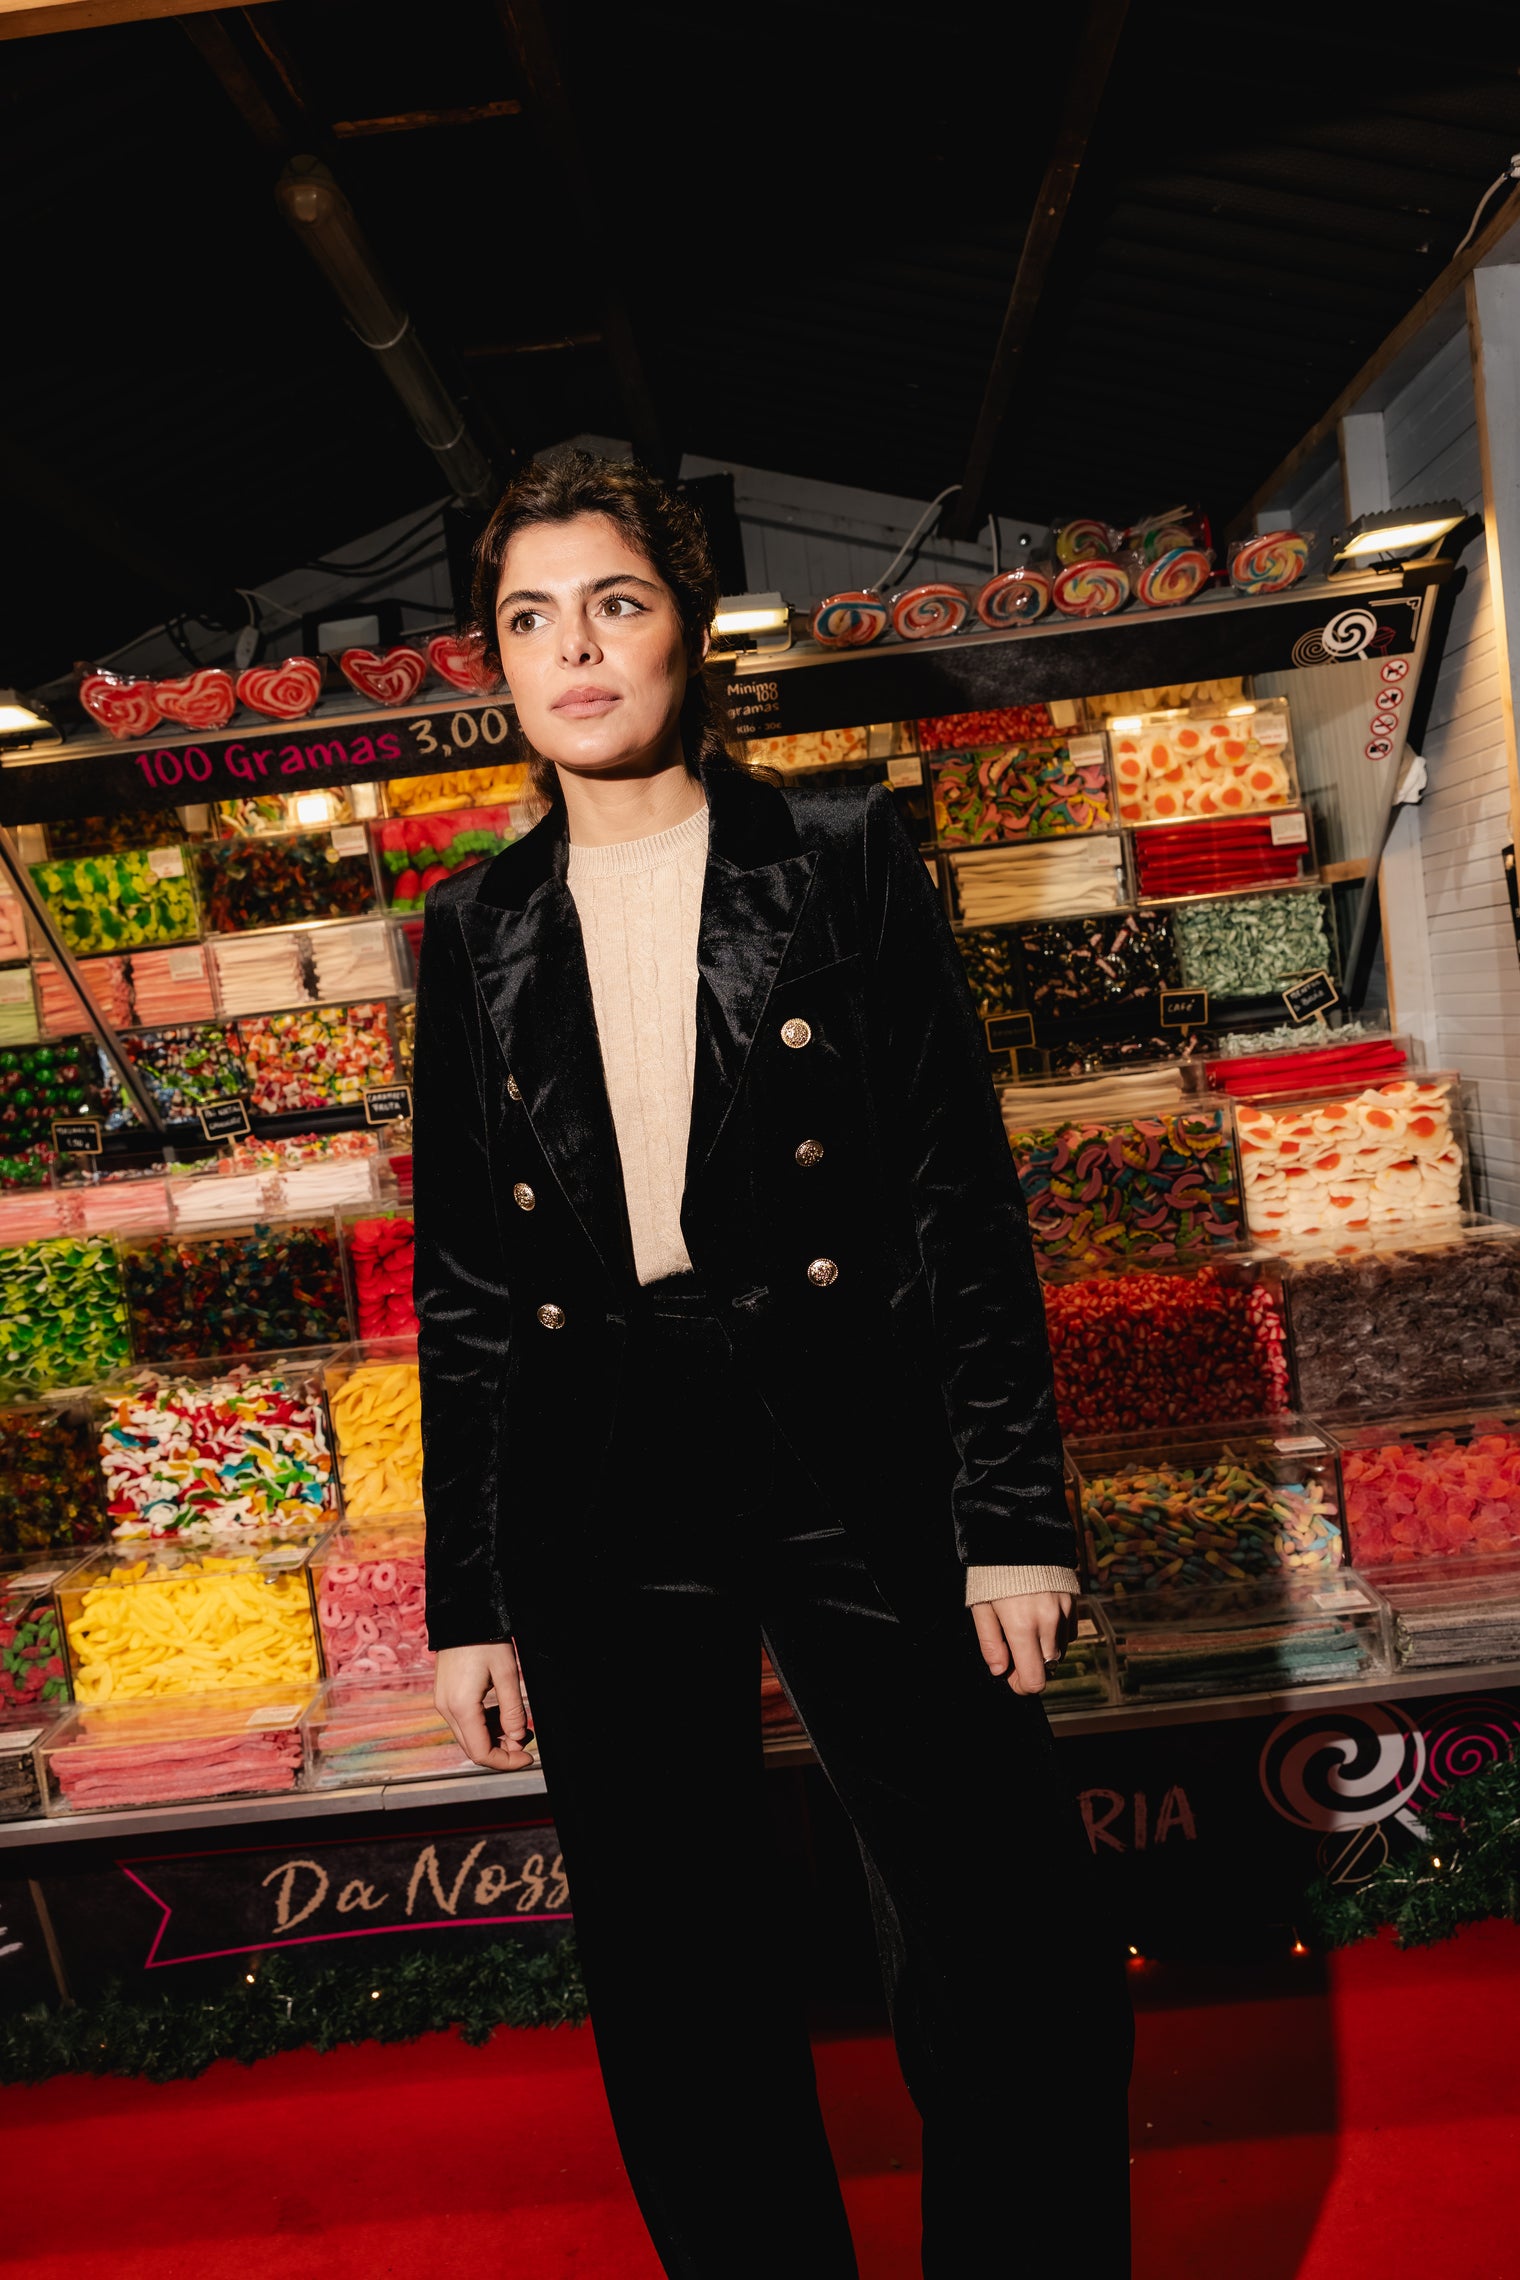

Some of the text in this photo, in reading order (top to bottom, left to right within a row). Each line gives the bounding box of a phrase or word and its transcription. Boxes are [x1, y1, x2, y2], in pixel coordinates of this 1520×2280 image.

[727, 702, 780, 720] gramas
[135, 707, 508, 788] 100 Gramas 3,00
[1076, 1784, 1198, 1855] RIA
[262, 1860, 389, 1934] Da
